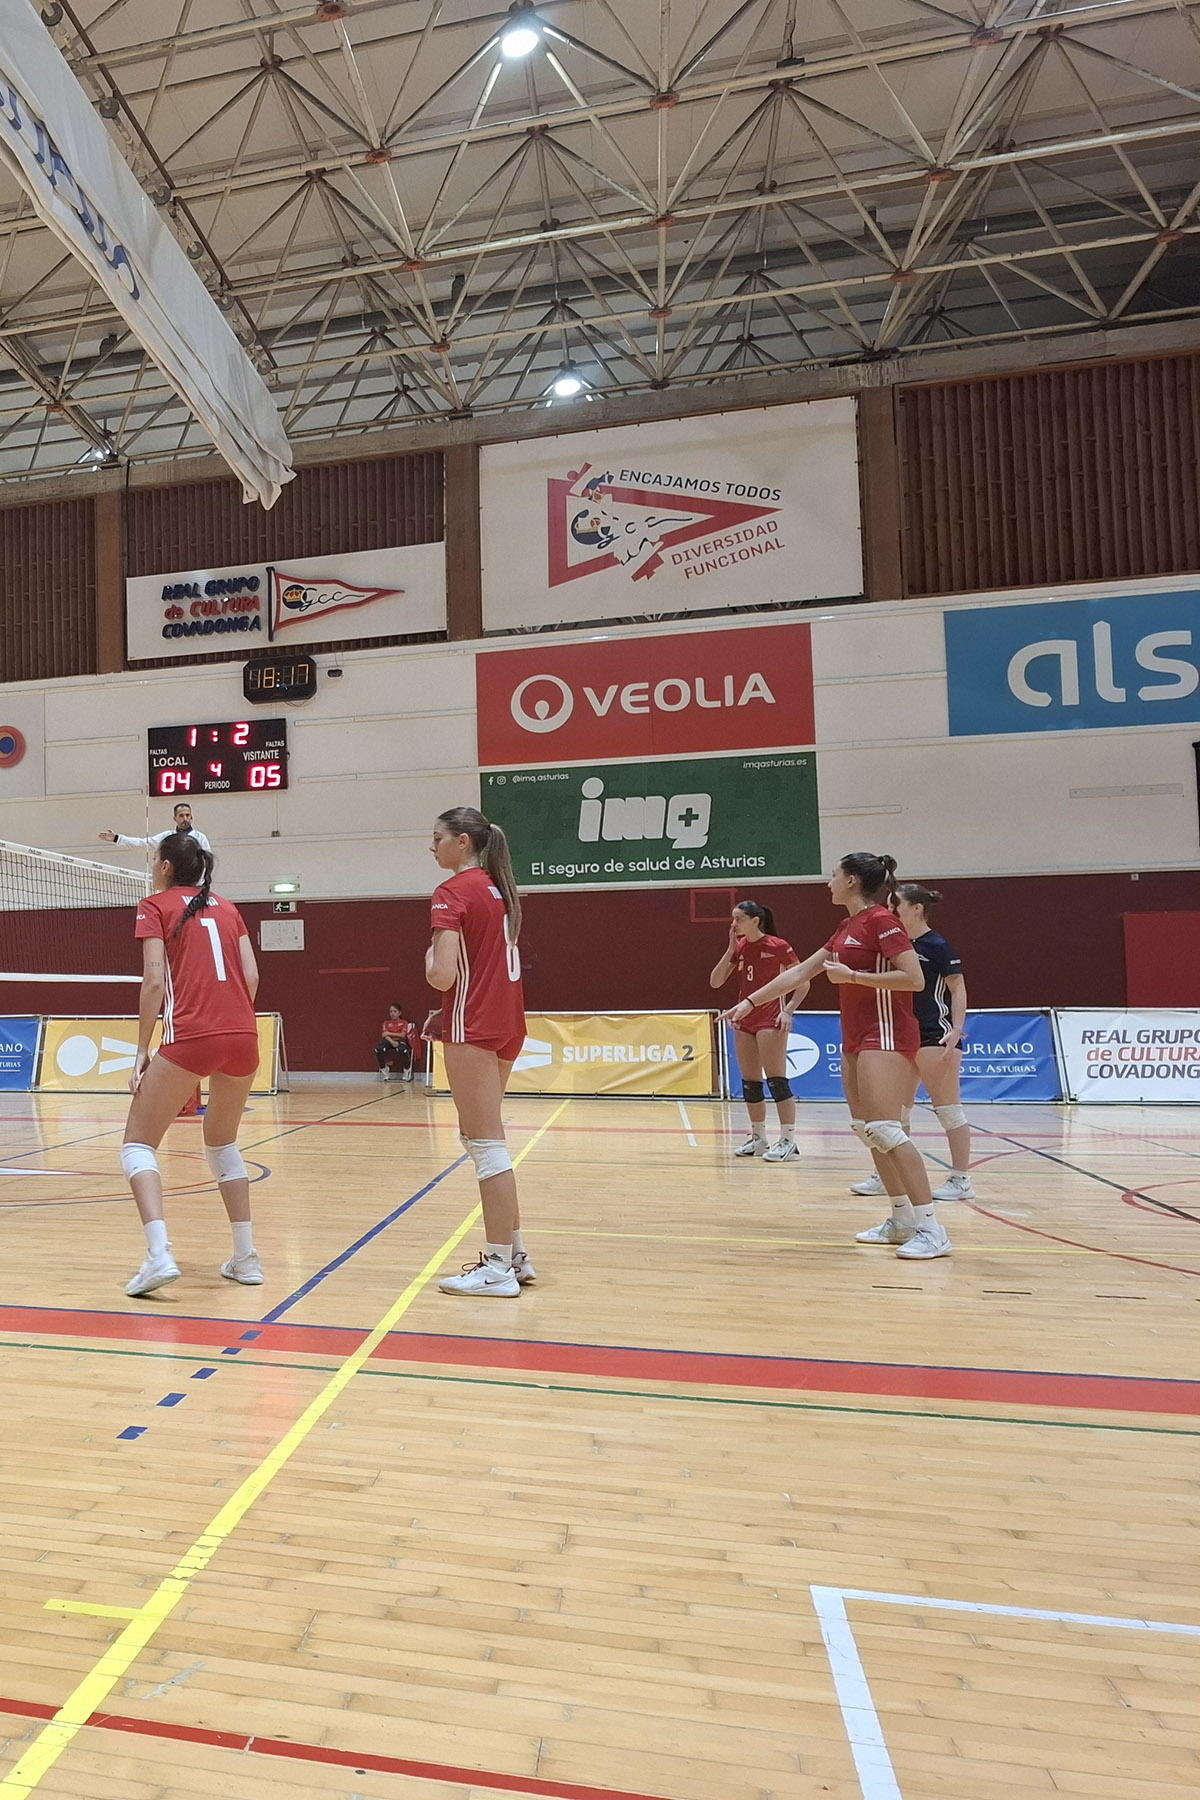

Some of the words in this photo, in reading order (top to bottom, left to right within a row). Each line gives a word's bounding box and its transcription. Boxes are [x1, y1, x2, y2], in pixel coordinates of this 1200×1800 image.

[619, 469, 721, 493] ENCAJAMOS
[726, 483, 782, 501] TODOS
[671, 520, 778, 566] DIVERSIDAD
[684, 538, 786, 579] FUNCIONAL
[161, 582, 202, 601] REAL
[204, 575, 260, 597] GRUPO
[164, 604, 185, 620] de
[189, 595, 260, 618] CULTURA
[162, 615, 261, 639] COVADONGA
[1007, 620, 1200, 707] als
[256, 663, 310, 689] 18:17
[583, 672, 776, 717] VEOLIA
[190, 727, 198, 747] 1
[233, 722, 249, 746] 2
[266, 740, 285, 748] FALTAS
[150, 748, 168, 756] FALTAS
[153, 756, 188, 767] LOCAL
[243, 749, 280, 761] VISITANTE
[743, 758, 808, 770] imqasturias.es
[160, 771, 191, 793] 04
[210, 763, 222, 777] 4
[250, 765, 281, 788] 05
[204, 780, 231, 790] PERIODO
[512, 772, 570, 784] @imq.asturias
[531, 862, 544, 876] El
[549, 860, 600, 878] seguro
[604, 859, 624, 873] de
[628, 857, 670, 871] salud
[675, 855, 695, 870] de
[700, 854, 766, 869] Asturias
[200, 918, 227, 981] 1
[746, 965, 754, 981] 3
[1081, 1030, 1132, 1044] REAL
[562, 1044, 678, 1062] SUPERLIGA
[682, 1044, 694, 1061] 2
[962, 1042, 1034, 1054] URIANO
[1087, 1047, 1112, 1061] de
[1118, 1047, 1200, 1061] CULTUR
[969, 1065, 982, 1073] DE
[986, 1063, 1037, 1073] ASTURIAS
[1087, 1064, 1200, 1079] COVADONG
